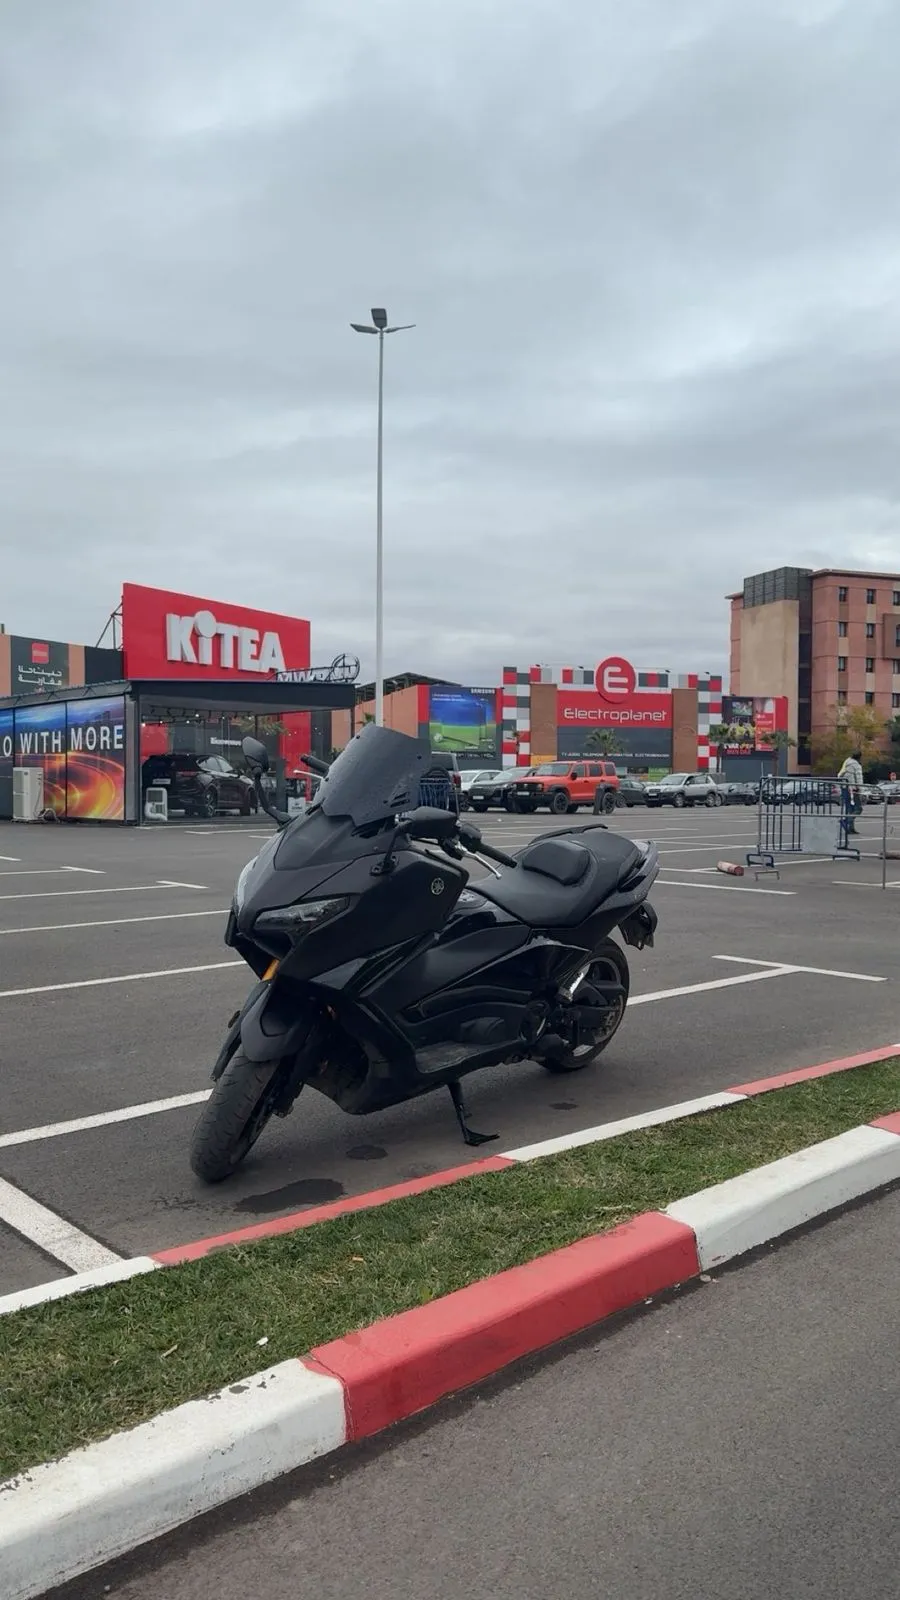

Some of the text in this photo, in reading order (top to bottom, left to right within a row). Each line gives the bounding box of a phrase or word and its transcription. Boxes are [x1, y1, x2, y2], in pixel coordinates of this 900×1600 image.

[603, 666, 629, 693] E
[563, 708, 667, 724] Electroplanet
[20, 731, 62, 754] WITH
[70, 725, 124, 751] MORE
